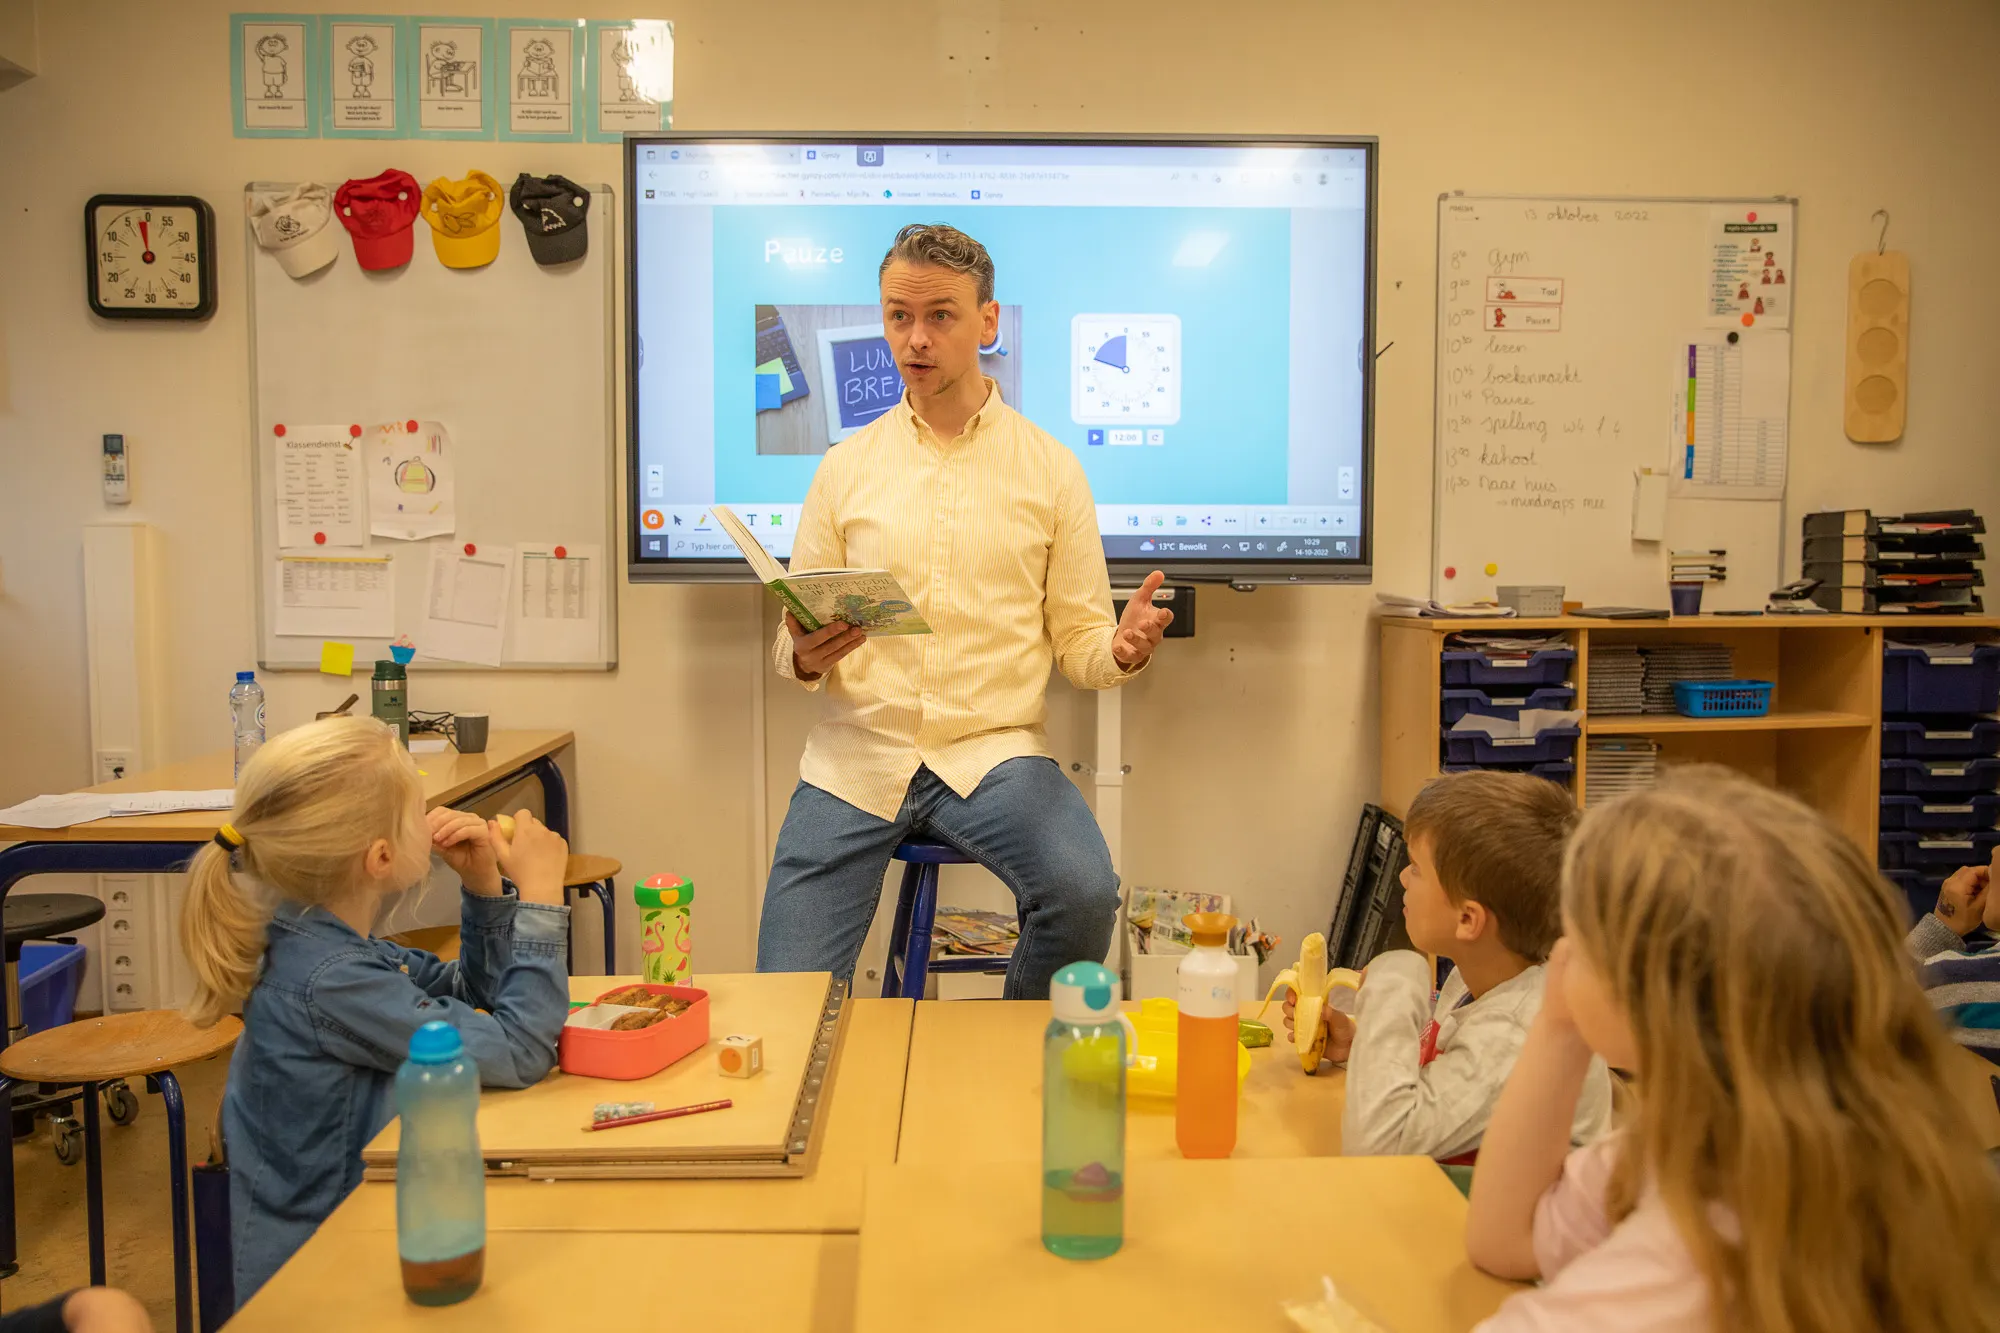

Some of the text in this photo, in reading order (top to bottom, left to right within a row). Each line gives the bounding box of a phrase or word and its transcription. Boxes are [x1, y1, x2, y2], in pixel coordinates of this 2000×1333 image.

[124, 216, 131, 227] 5
[144, 212, 151, 222] 0
[162, 216, 174, 227] 55
[107, 231, 118, 242] 10
[178, 231, 190, 242] 50
[764, 240, 844, 263] Pauze
[102, 252, 114, 263] 15
[184, 252, 196, 264] 45
[108, 272, 119, 283] 20
[179, 272, 191, 284] 40
[124, 288, 136, 299] 25
[144, 293, 156, 304] 30
[166, 288, 178, 299] 35
[849, 348, 896, 373] LUN
[844, 375, 906, 405] BRE
[1114, 434, 1137, 442] 12:00
[286, 439, 342, 452] Klassendienst
[1478, 442, 1540, 467] kahoot
[691, 542, 704, 552] Typ
[706, 542, 721, 550] hier
[1178, 542, 1208, 551] Bewolkt
[797, 583, 822, 591] EEN
